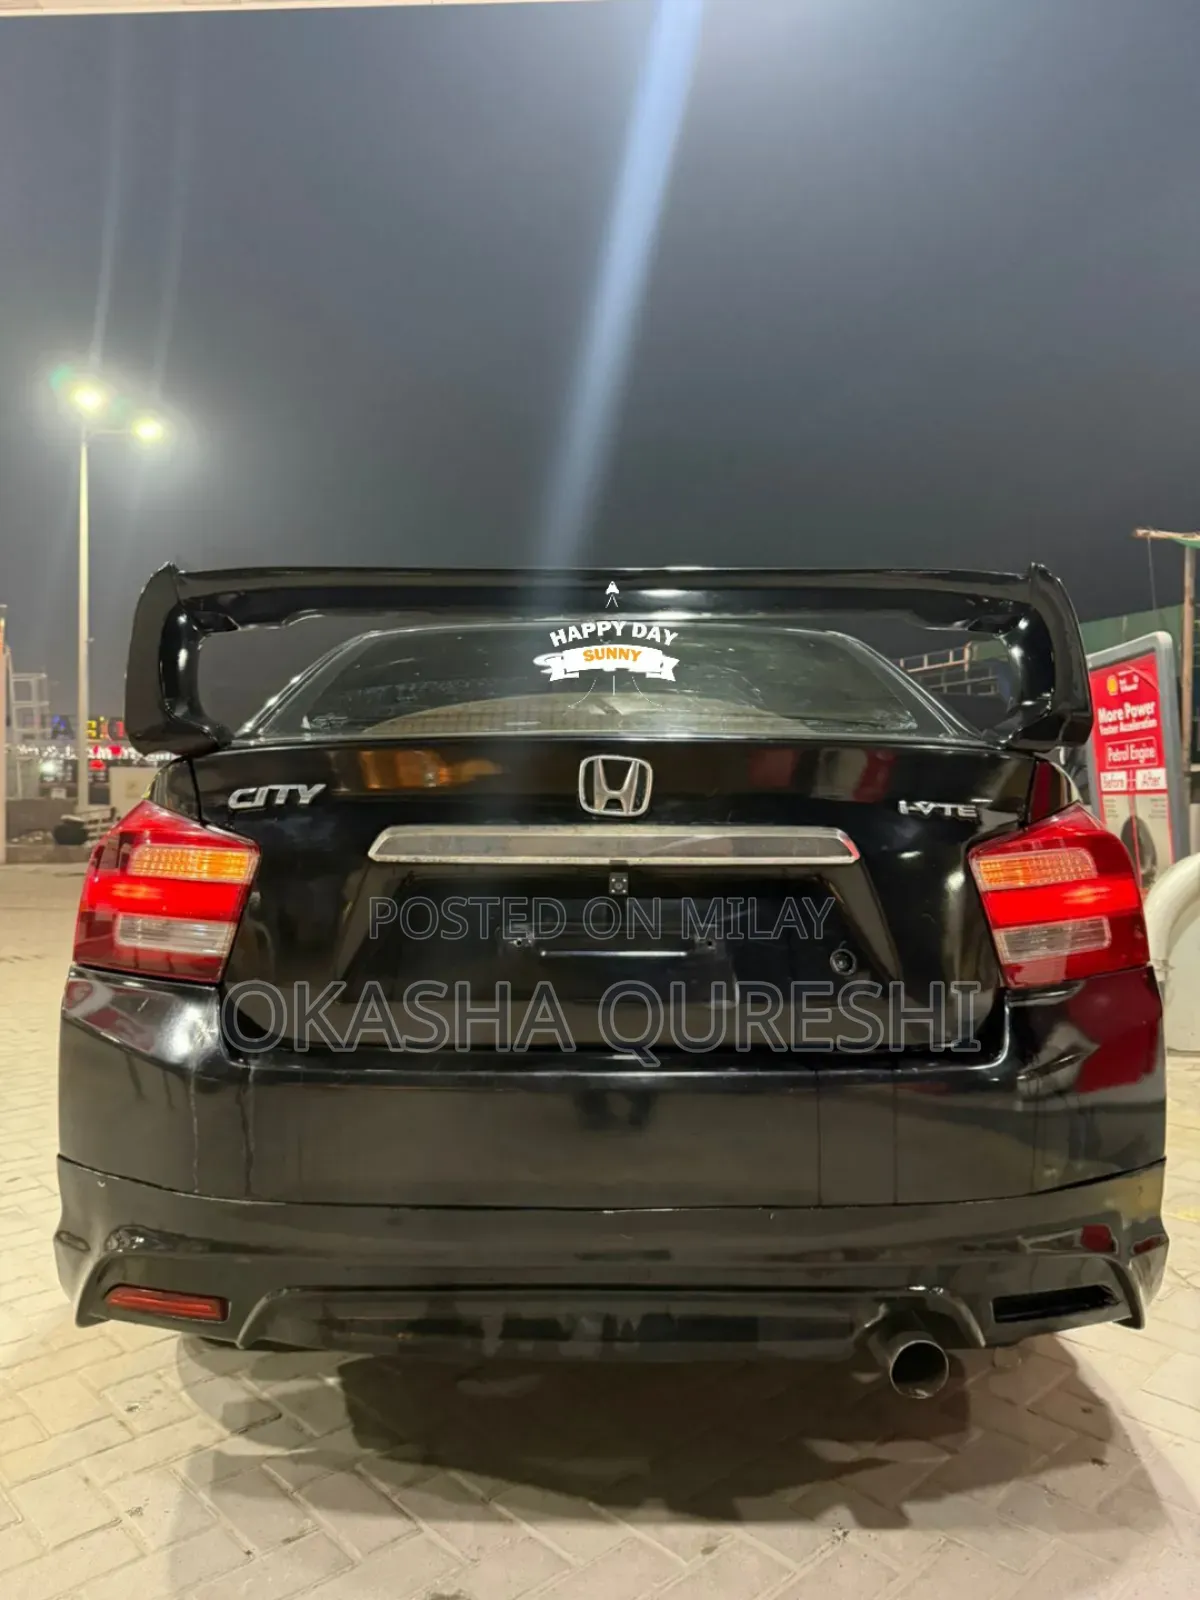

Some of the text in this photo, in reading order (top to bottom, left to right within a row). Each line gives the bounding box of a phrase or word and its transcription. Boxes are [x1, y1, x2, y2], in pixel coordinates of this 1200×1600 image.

[1098, 701, 1156, 723] More Power
[1107, 743, 1156, 764] Petrol Engine
[228, 784, 327, 809] CITY
